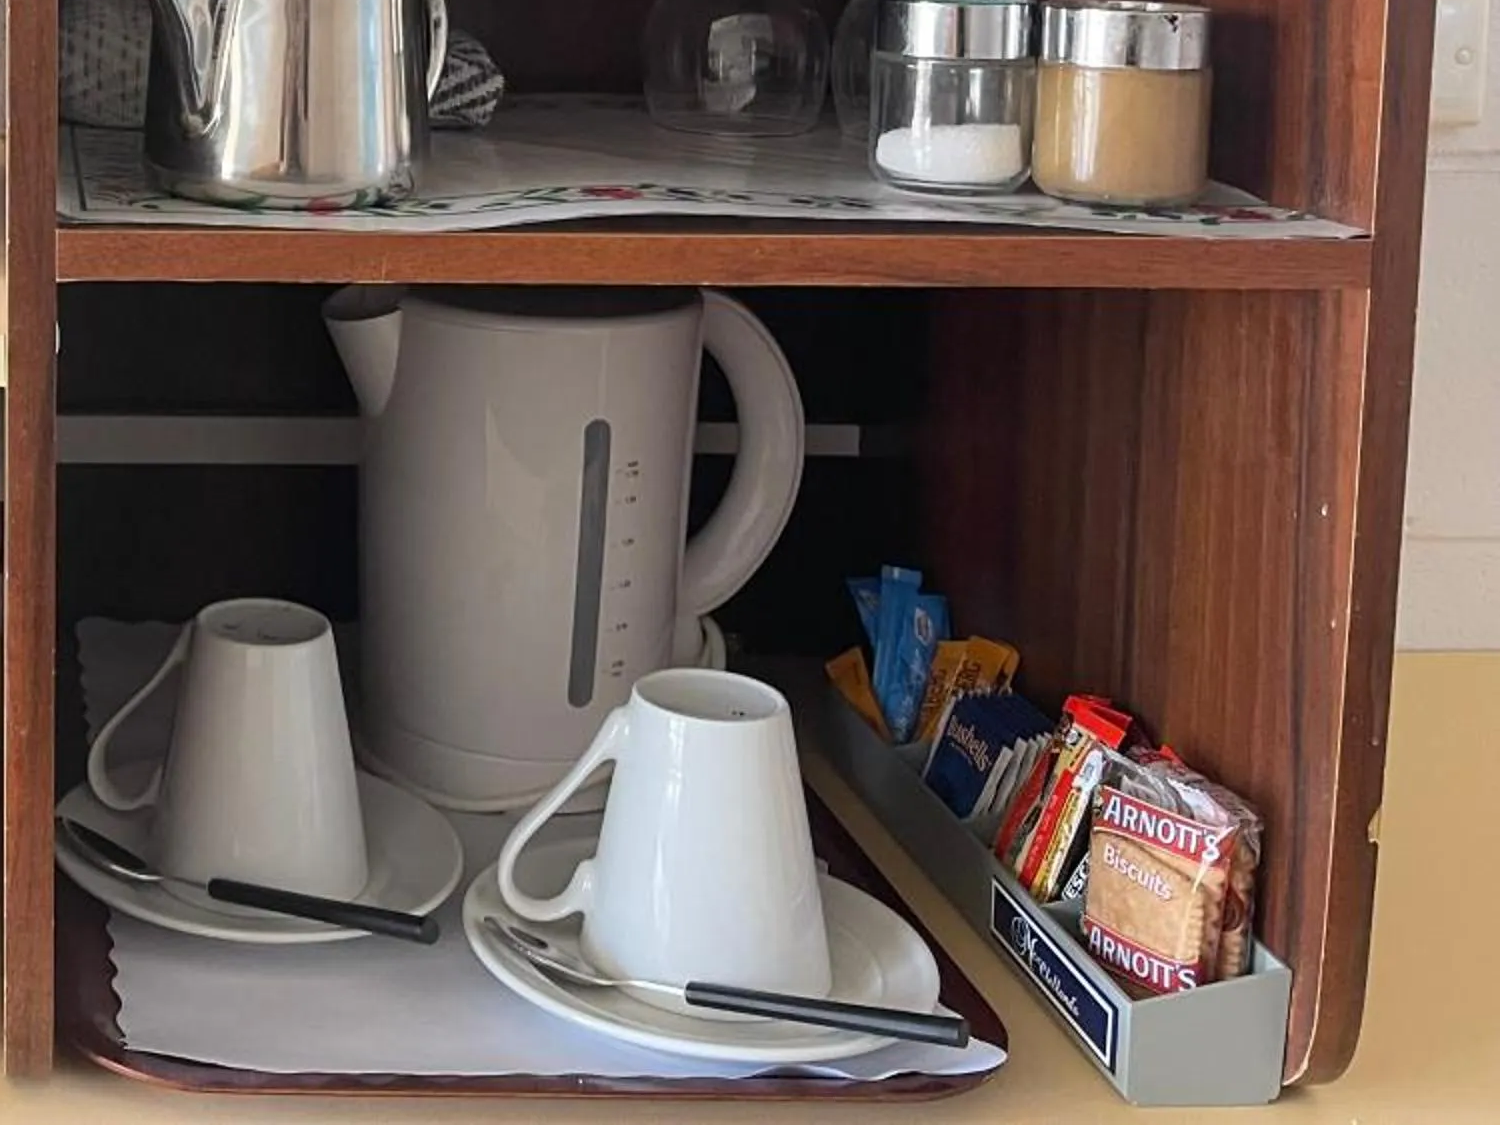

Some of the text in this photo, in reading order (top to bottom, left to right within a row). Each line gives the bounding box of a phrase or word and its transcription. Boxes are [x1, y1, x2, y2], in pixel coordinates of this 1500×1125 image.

[1103, 795, 1221, 861] ARNOTT'S
[1102, 842, 1173, 901] Biscuits
[1089, 926, 1198, 991] ARNOTT'S
